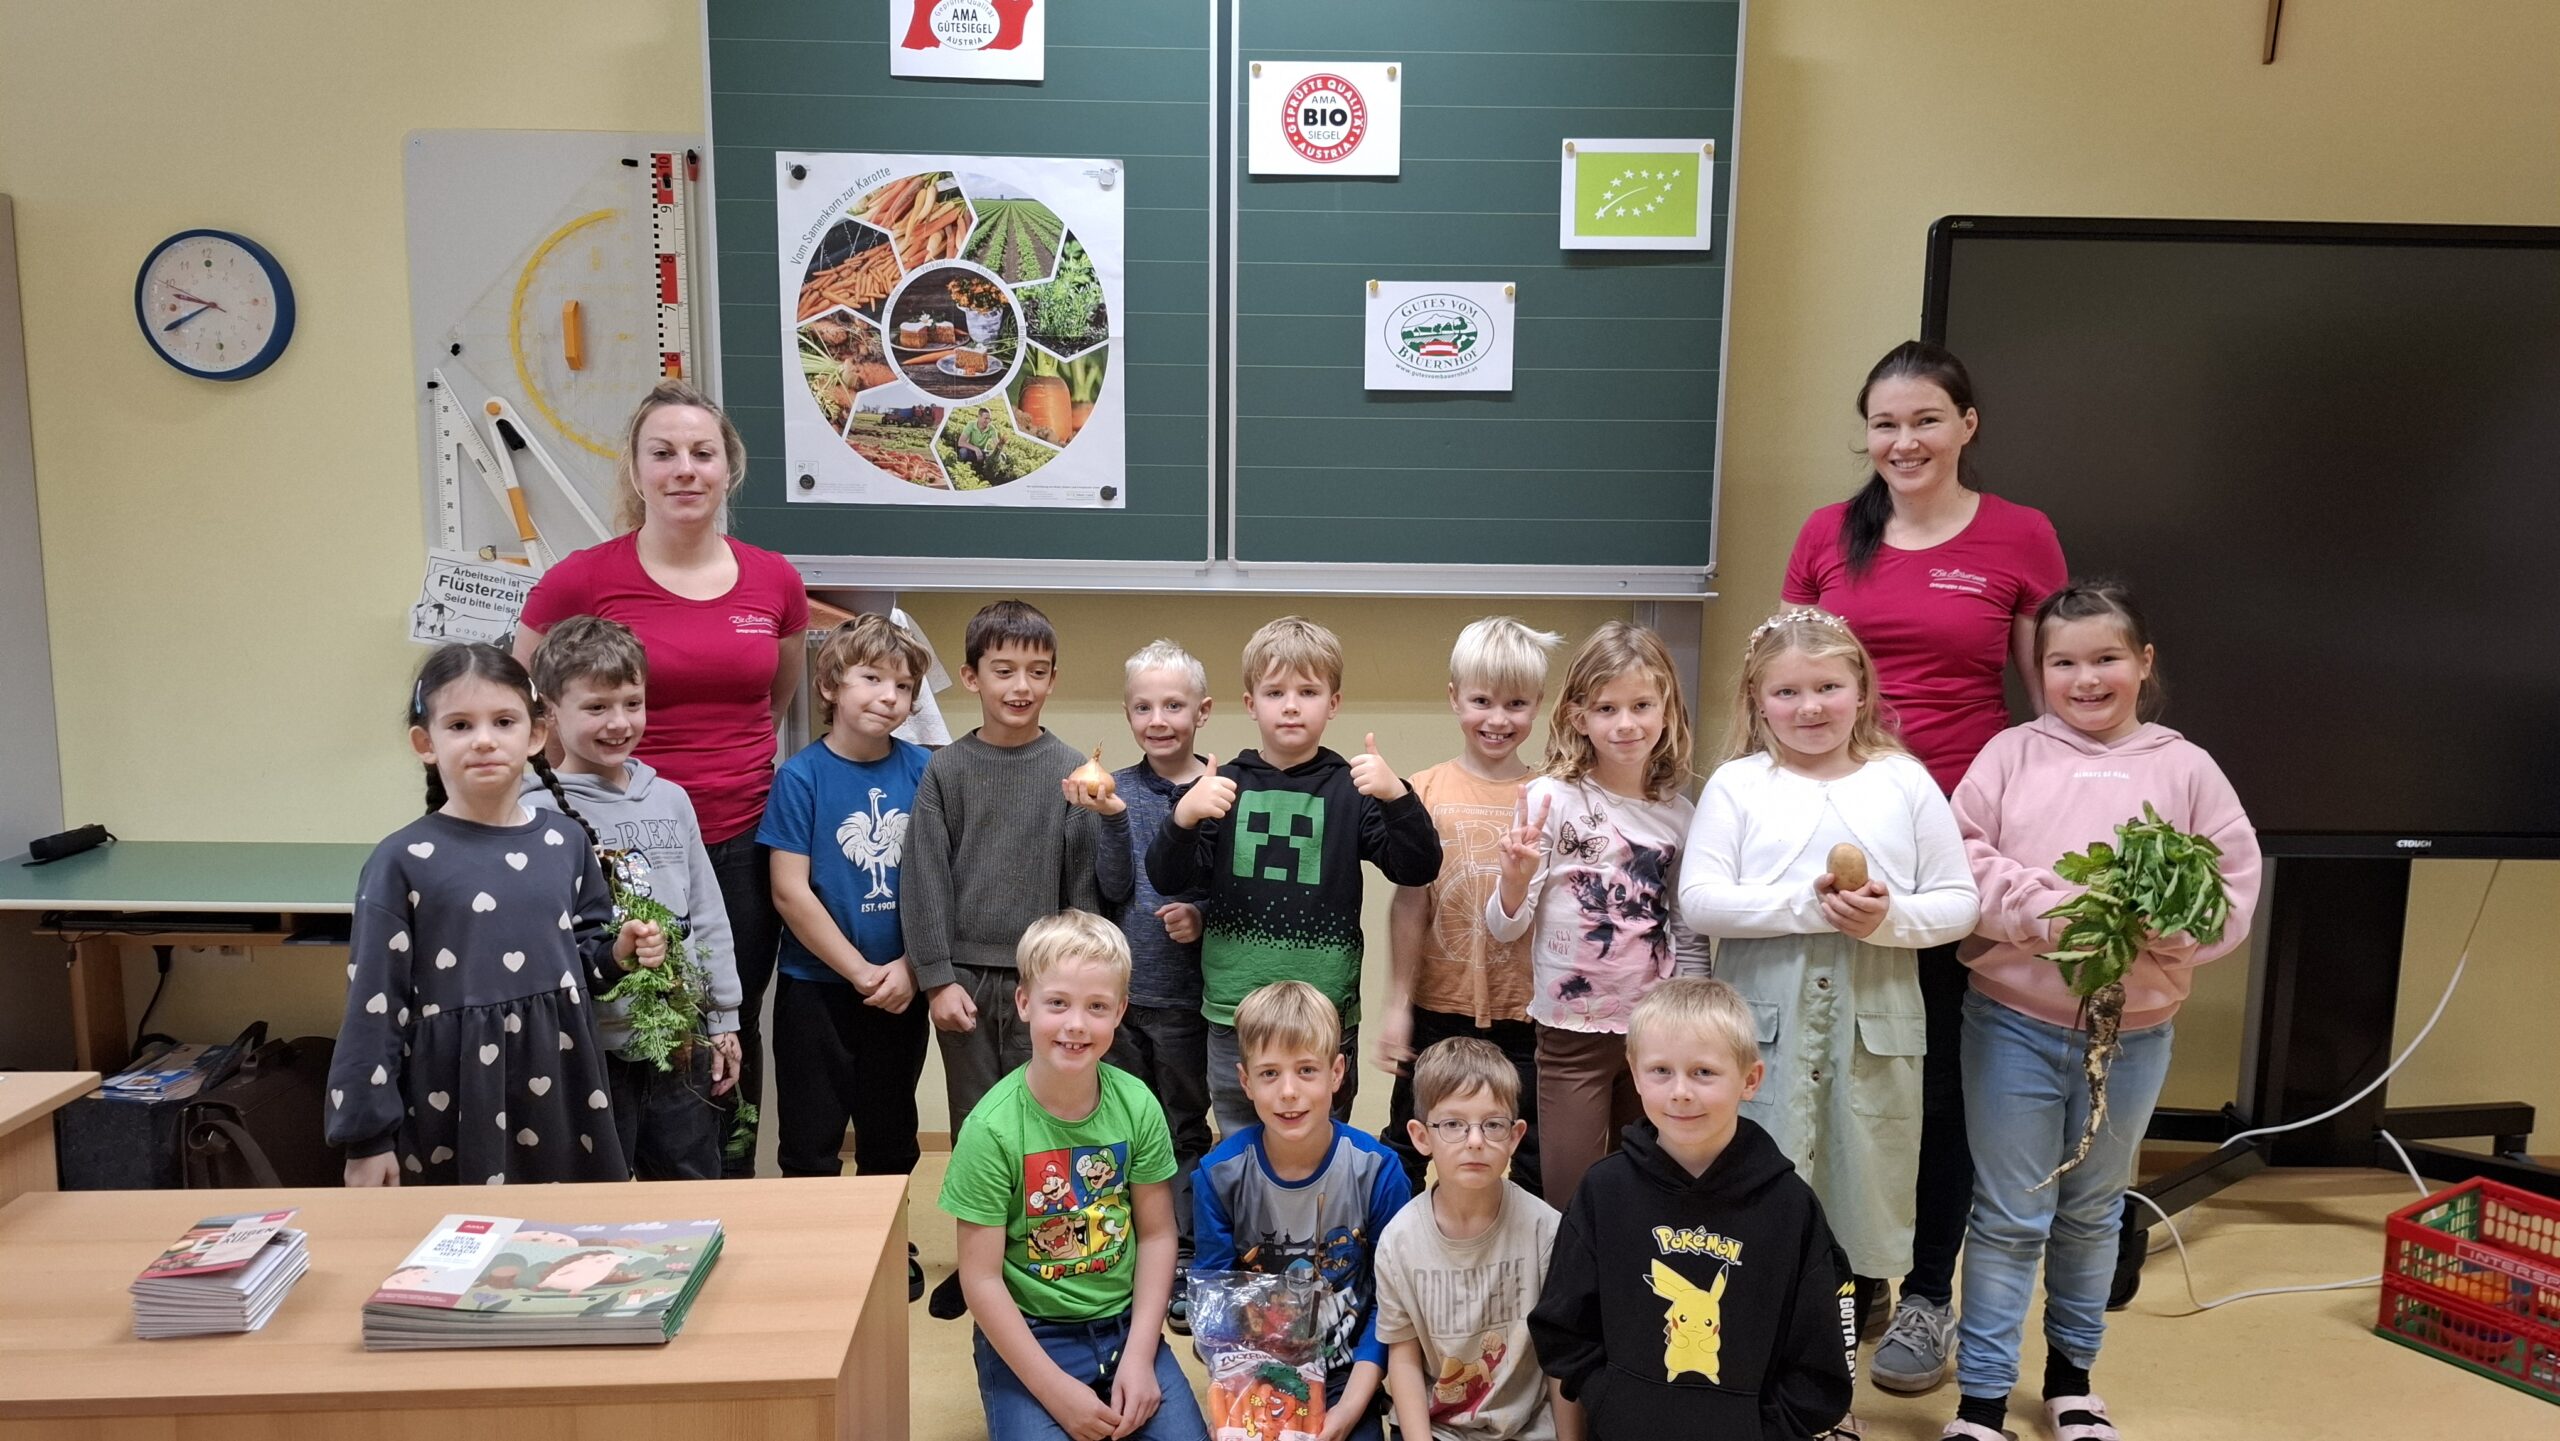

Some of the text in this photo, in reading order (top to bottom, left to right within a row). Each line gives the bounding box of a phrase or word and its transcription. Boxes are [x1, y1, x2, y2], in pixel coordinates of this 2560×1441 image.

[952, 8, 978, 22] AMA
[937, 20, 992, 34] GÜTESIEGEL
[946, 36, 983, 46] AUSTRIA
[1286, 79, 1364, 135] GEPRÜFTE QUALITÄT
[1311, 95, 1337, 104] AMA
[1303, 108, 1348, 127] BIO
[1308, 130, 1341, 140] SIEGEL
[1298, 141, 1352, 159] AUSTRIA
[658, 156, 670, 169] 10
[790, 244, 809, 266] Vom
[802, 197, 844, 244] Samenkorn
[841, 186, 856, 201] zur
[854, 167, 892, 190] Karotte
[1401, 298, 1478, 318] GUTES VOM
[1397, 346, 1478, 370] BAUERNHOF
[453, 567, 520, 588] Arbeitszeit ist
[438, 575, 524, 604] Flüsterzeit
[444, 592, 520, 615] Seid bitte leise!
[2396, 839, 2432, 848] CTOUCH
[1027, 1240, 1128, 1281] SUPER MARO
[2470, 1250, 2560, 1286] INTERSP
[1839, 1297, 1856, 1347] GOTTA
